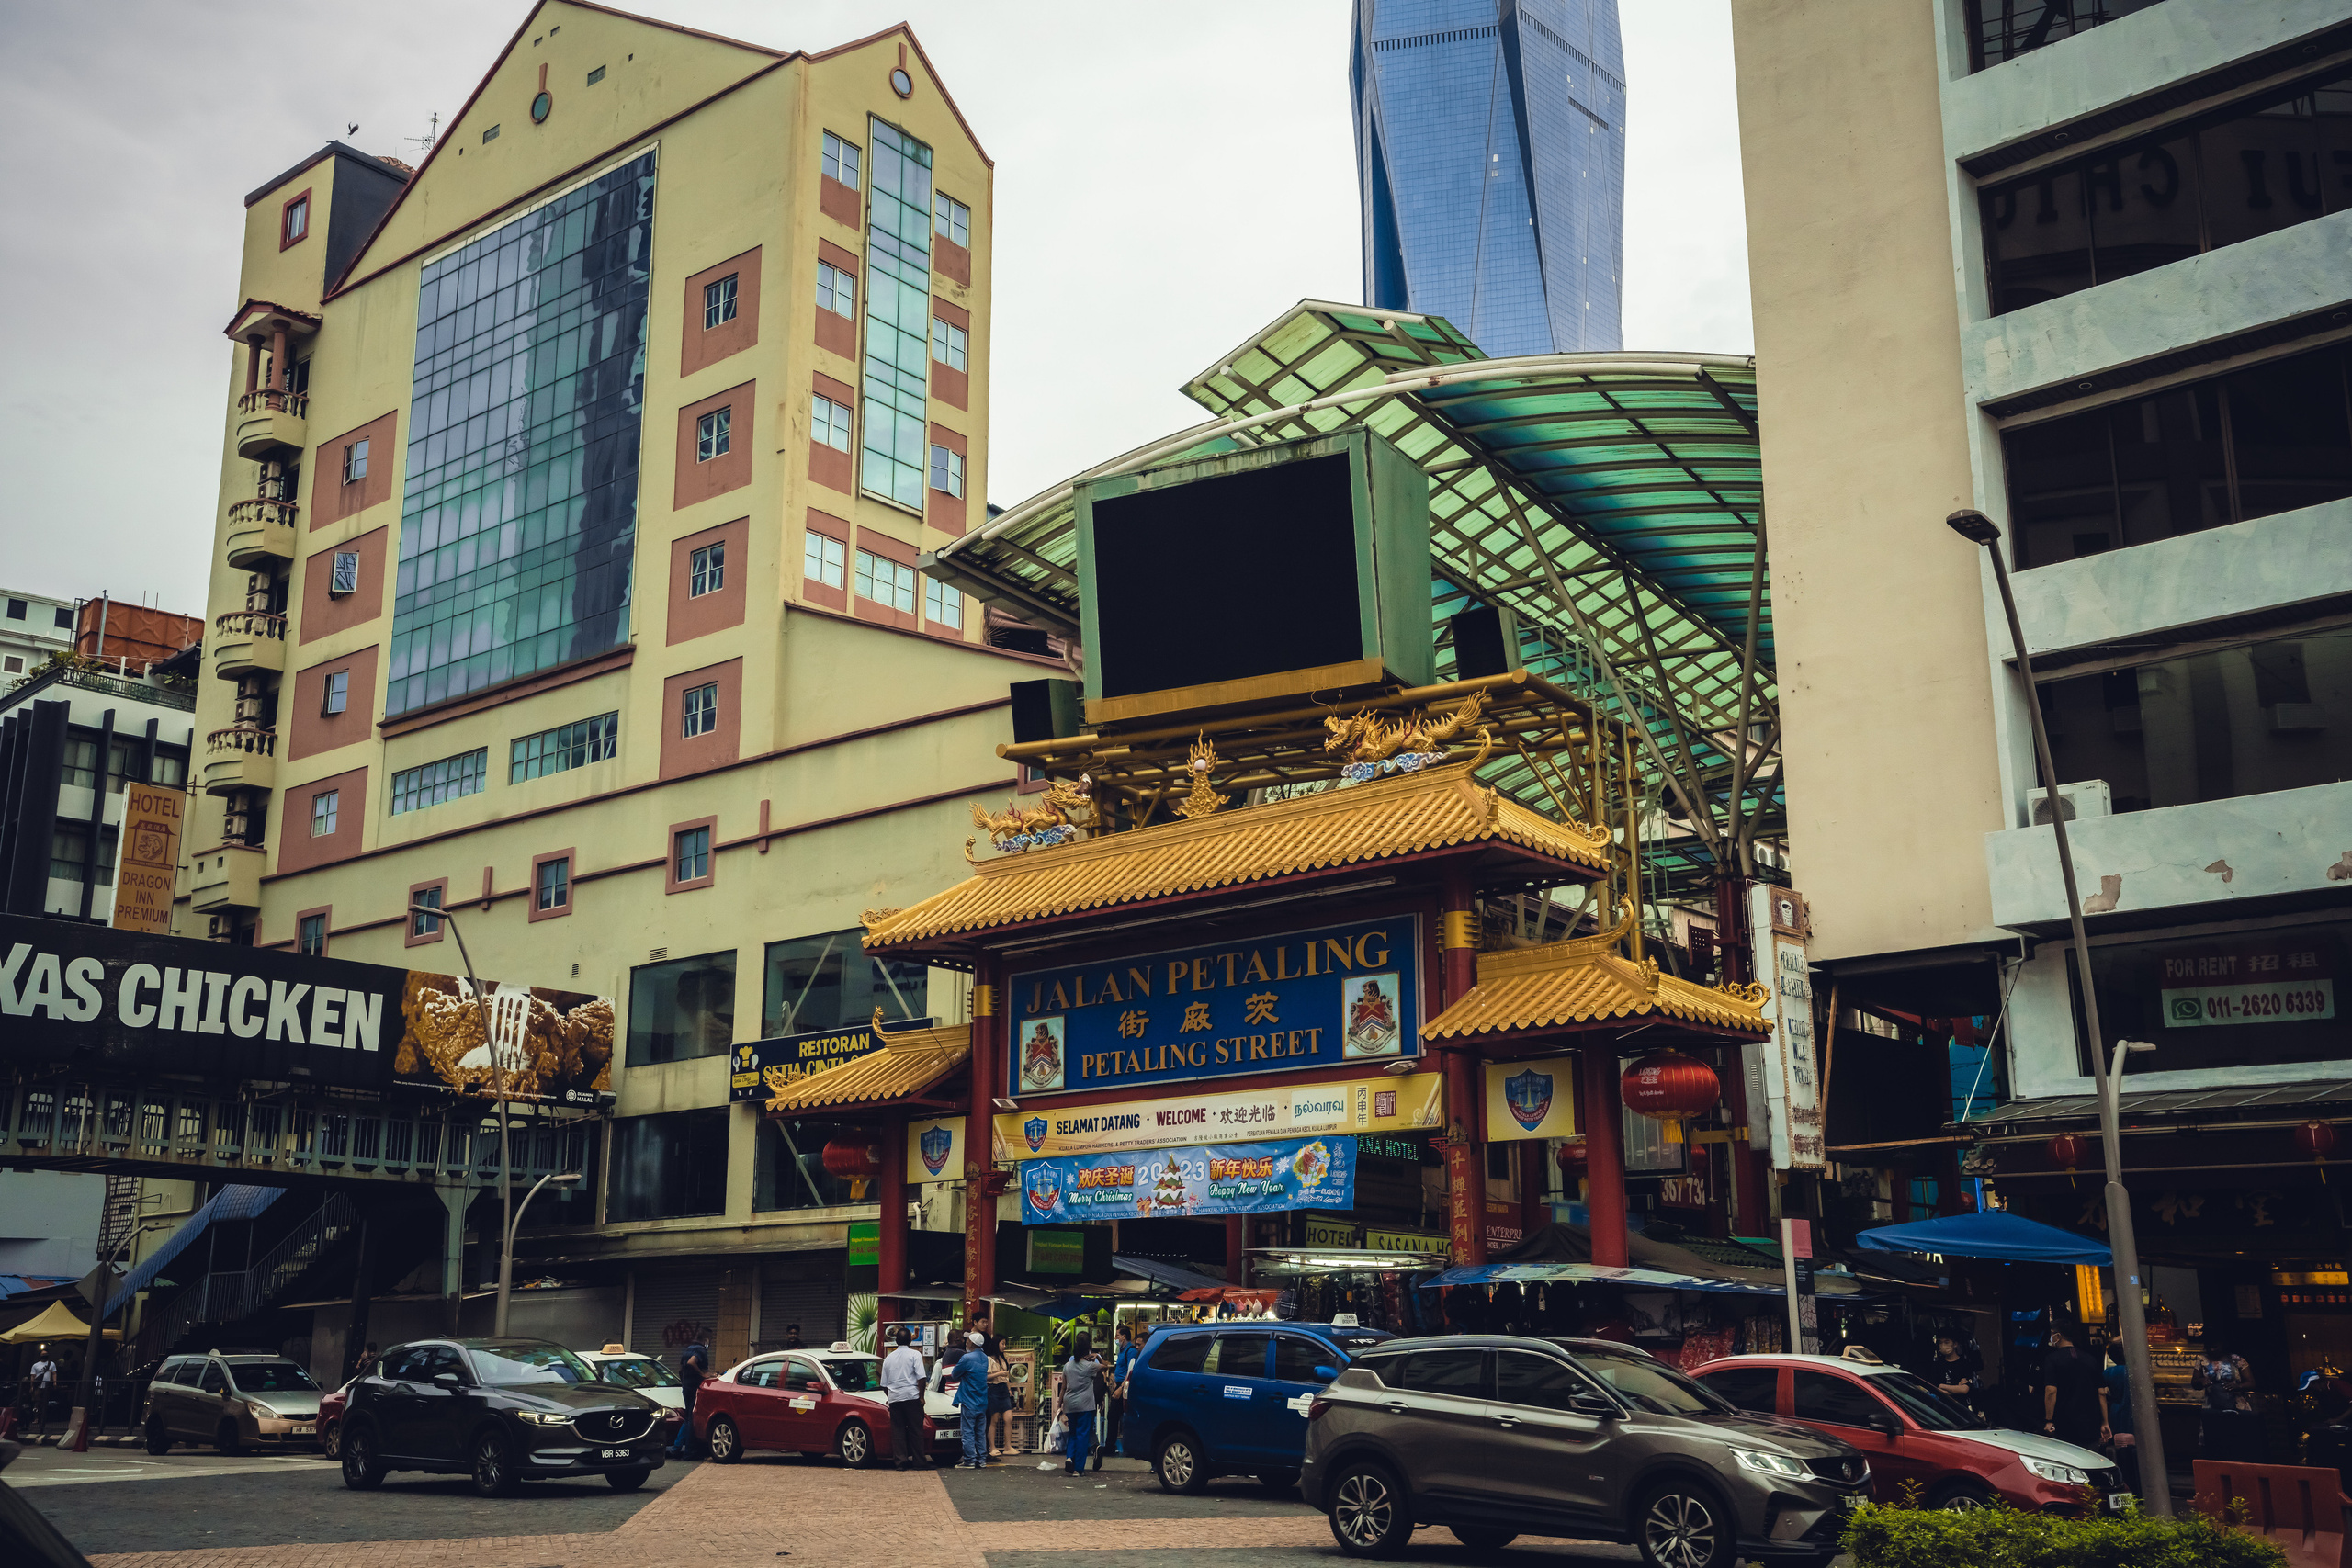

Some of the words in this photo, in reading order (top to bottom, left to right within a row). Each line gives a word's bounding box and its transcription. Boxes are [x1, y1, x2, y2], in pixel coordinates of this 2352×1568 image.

[130, 792, 179, 818] HOTEL
[122, 872, 171, 891] DRAGON
[135, 890, 154, 906] INN
[117, 905, 168, 924] PREMIUM
[1026, 965, 1153, 1014] JALAN
[1167, 930, 1391, 995] PETALING
[2165, 959, 2194, 978] FOR
[2199, 955, 2237, 976] RENT
[2248, 951, 2319, 973] 招租
[118, 964, 384, 1052] CHICKEN
[2207, 993, 2281, 1019] 011-2620
[2285, 990, 2325, 1014] 6339
[798, 1032, 870, 1058] RESTORAN
[1081, 1041, 1208, 1078] PETALING
[1216, 1028, 1323, 1065] STREET
[1156, 1107, 1207, 1127] WELCOME
[1219, 1104, 1276, 1125] 欢迎光临
[1356, 1087, 1368, 1126] 丙申年
[1057, 1118, 1099, 1135] SELAMAT
[1101, 1113, 1141, 1132] DATANG
[1157, 1136, 1187, 1145] ASSOCIATION
[1355, 1135, 1383, 1156] ANA
[1385, 1139, 1419, 1161] HOTEL
[1076, 1165, 1135, 1190] 欢庆圣诞
[1209, 1156, 1273, 1180] 新年快乐
[1068, 1190, 1091, 1205] Merry
[1094, 1189, 1134, 1204] Christmas
[1209, 1182, 1236, 1199] Happy
[1237, 1180, 1258, 1194] New
[1260, 1179, 1285, 1195] Year
[1307, 1227, 1352, 1247] HOTEL
[1378, 1235, 1430, 1252] SASANA
[601, 1450, 614, 1459] VBR
[615, 1449, 630, 1458] 5363
